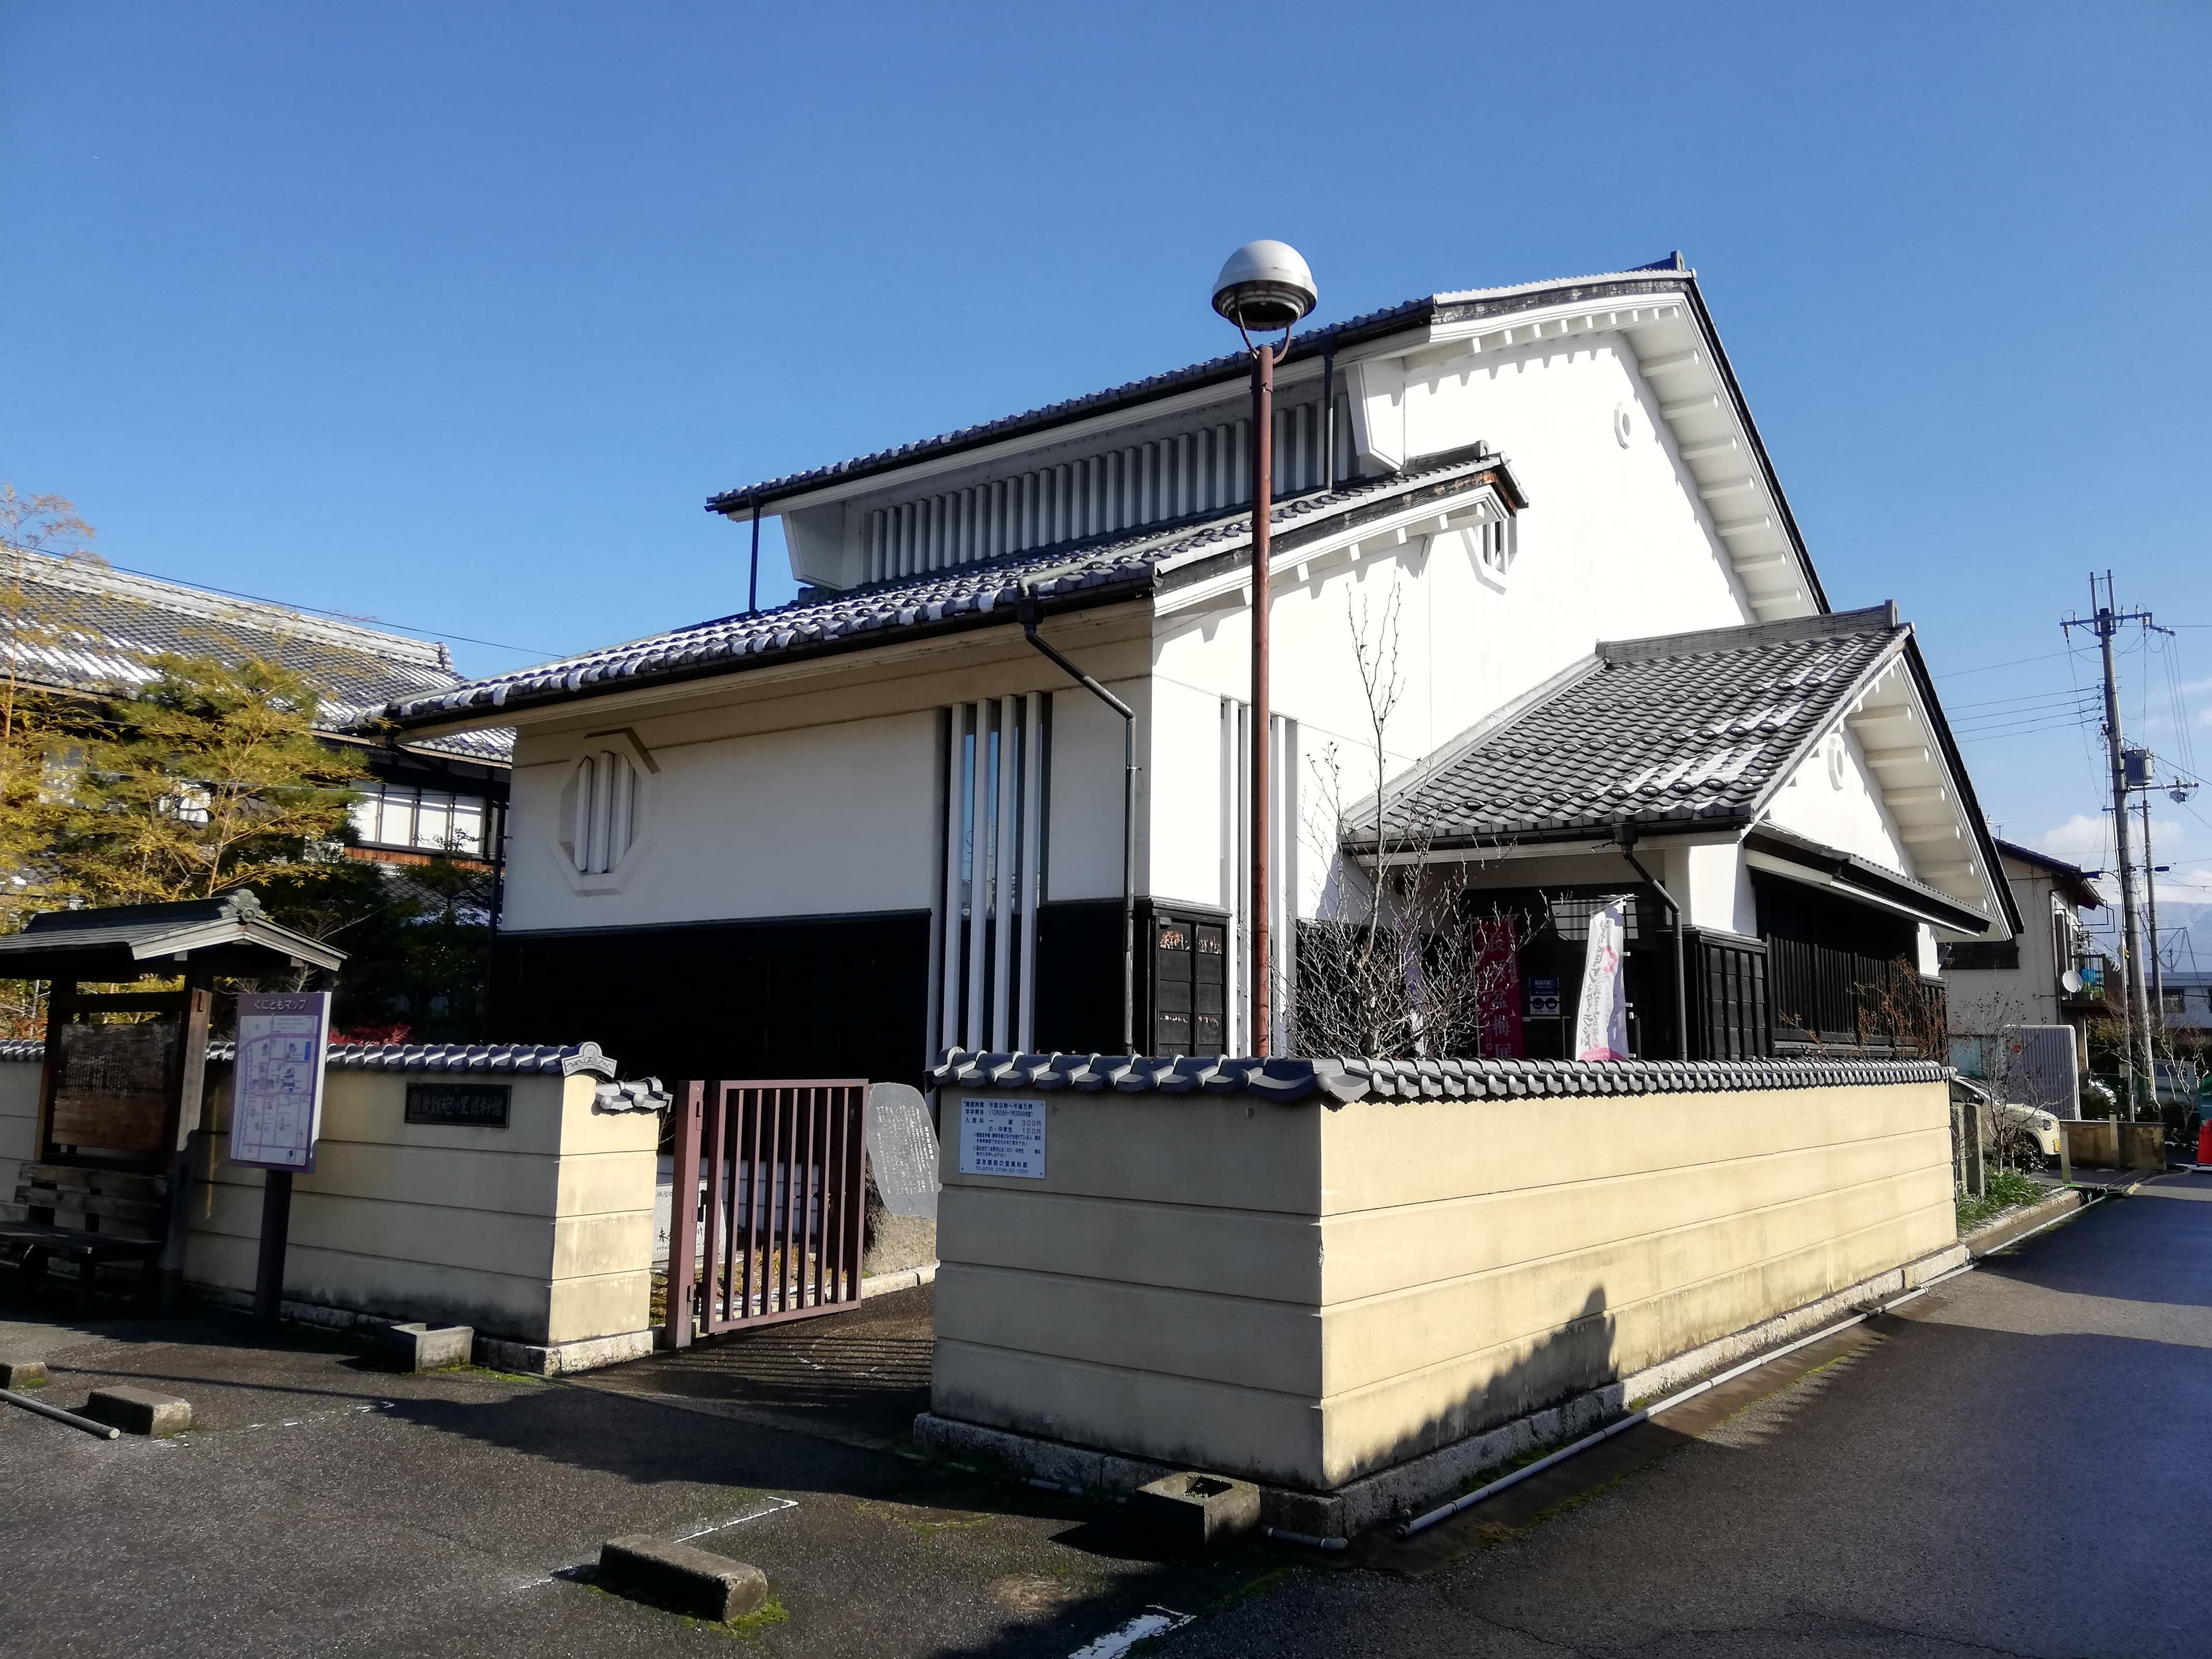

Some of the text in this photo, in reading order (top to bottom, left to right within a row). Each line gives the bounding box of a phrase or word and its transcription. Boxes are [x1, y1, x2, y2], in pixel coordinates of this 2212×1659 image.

[253, 998, 307, 1010] くにともマップ
